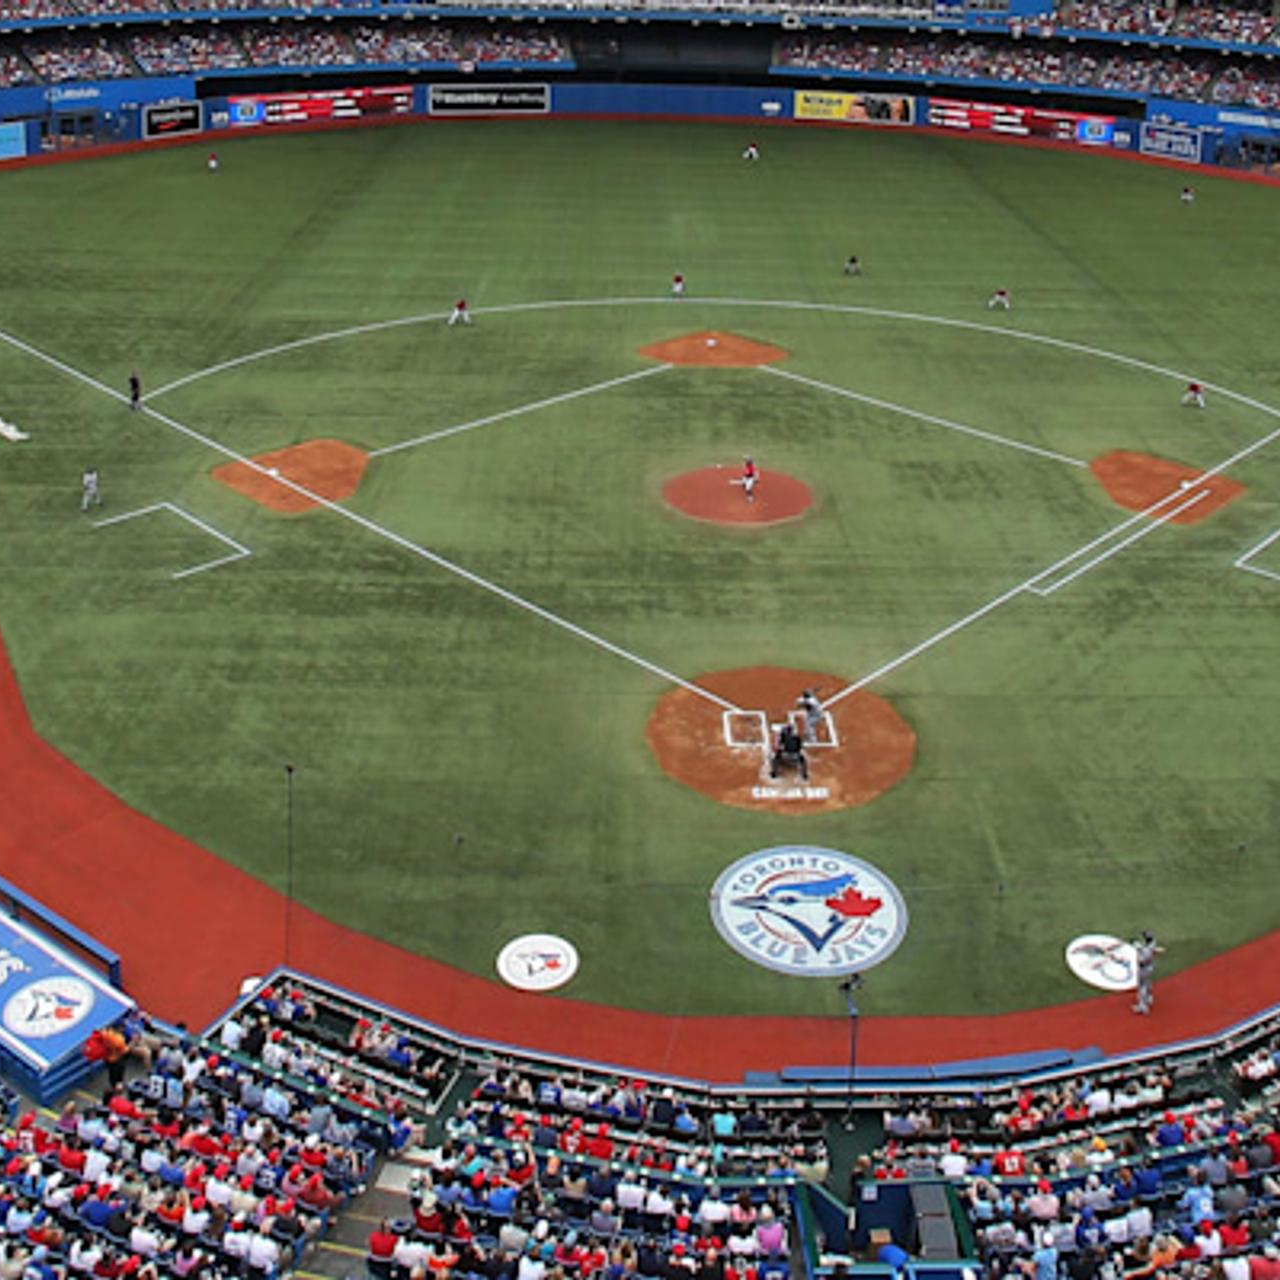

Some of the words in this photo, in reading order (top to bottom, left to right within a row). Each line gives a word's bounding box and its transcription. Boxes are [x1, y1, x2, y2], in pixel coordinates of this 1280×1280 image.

[732, 857, 840, 893] TORONTO
[736, 920, 808, 965] BLUE
[828, 924, 888, 965] JAYS
